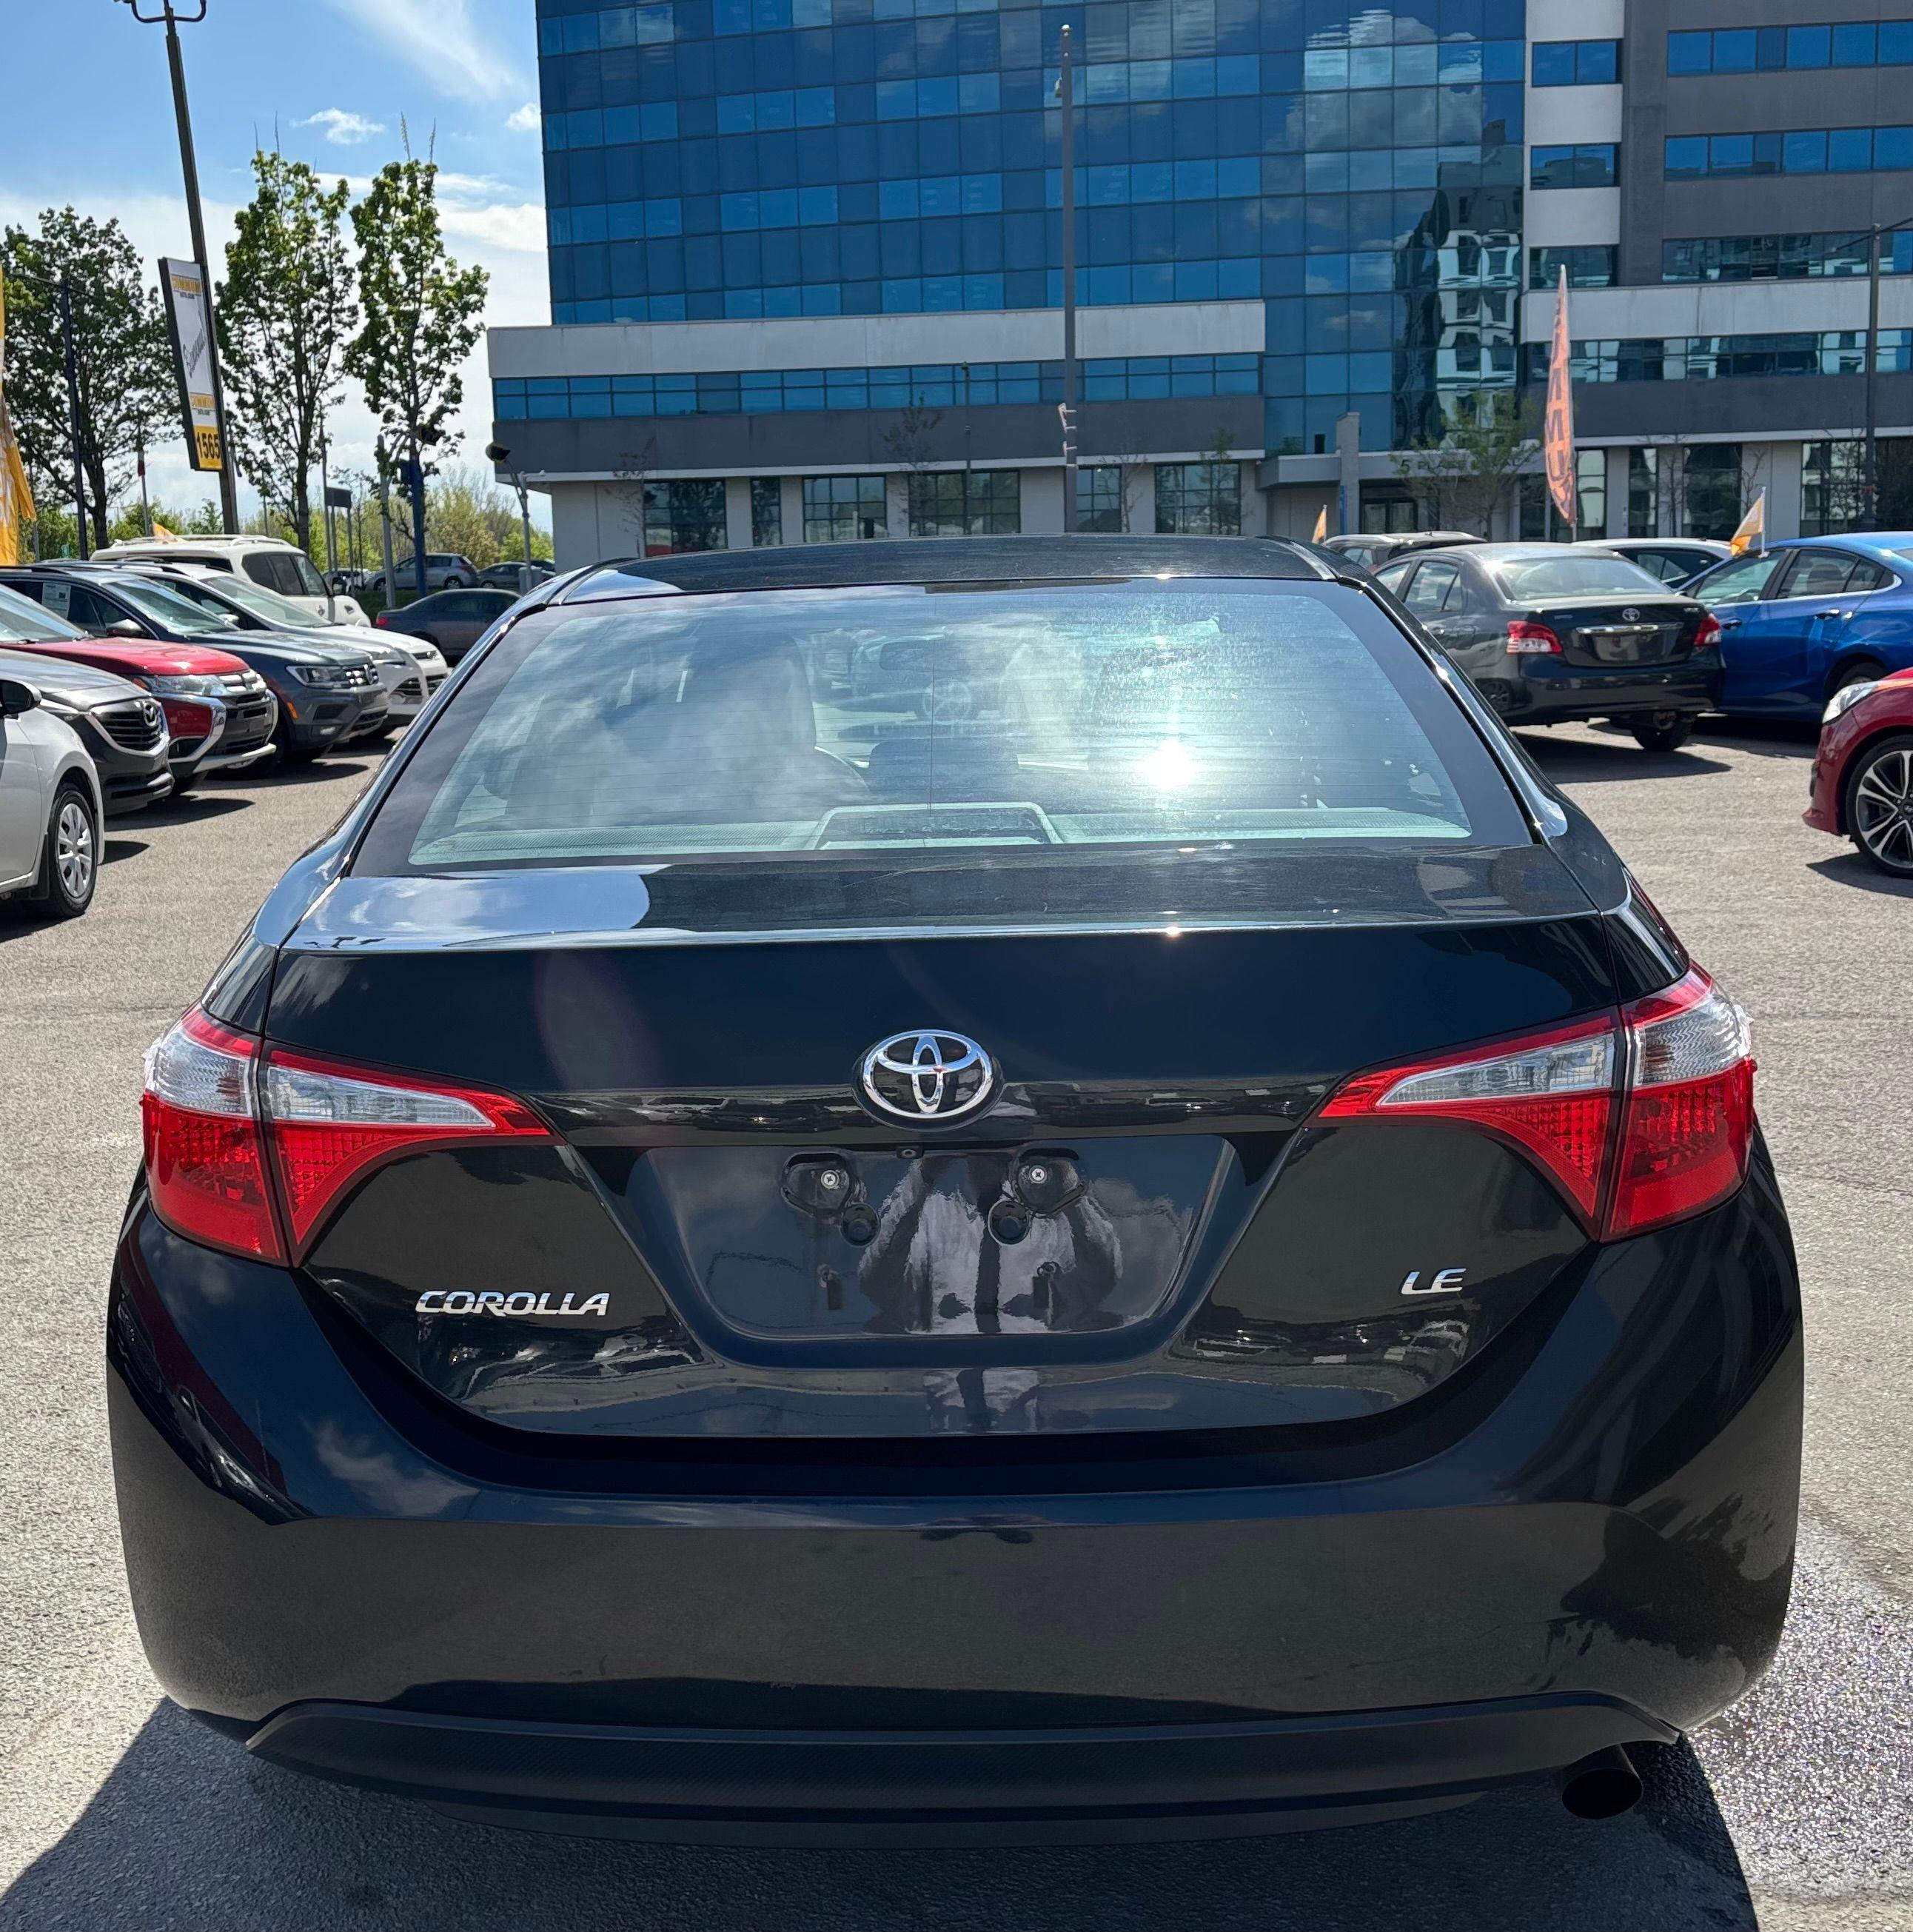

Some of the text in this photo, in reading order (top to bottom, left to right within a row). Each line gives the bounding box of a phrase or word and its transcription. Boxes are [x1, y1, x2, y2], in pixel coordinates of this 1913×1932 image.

[196, 431, 221, 460] 1565
[1401, 1268, 1467, 1295] LE
[415, 1289, 610, 1317] COROLLA
